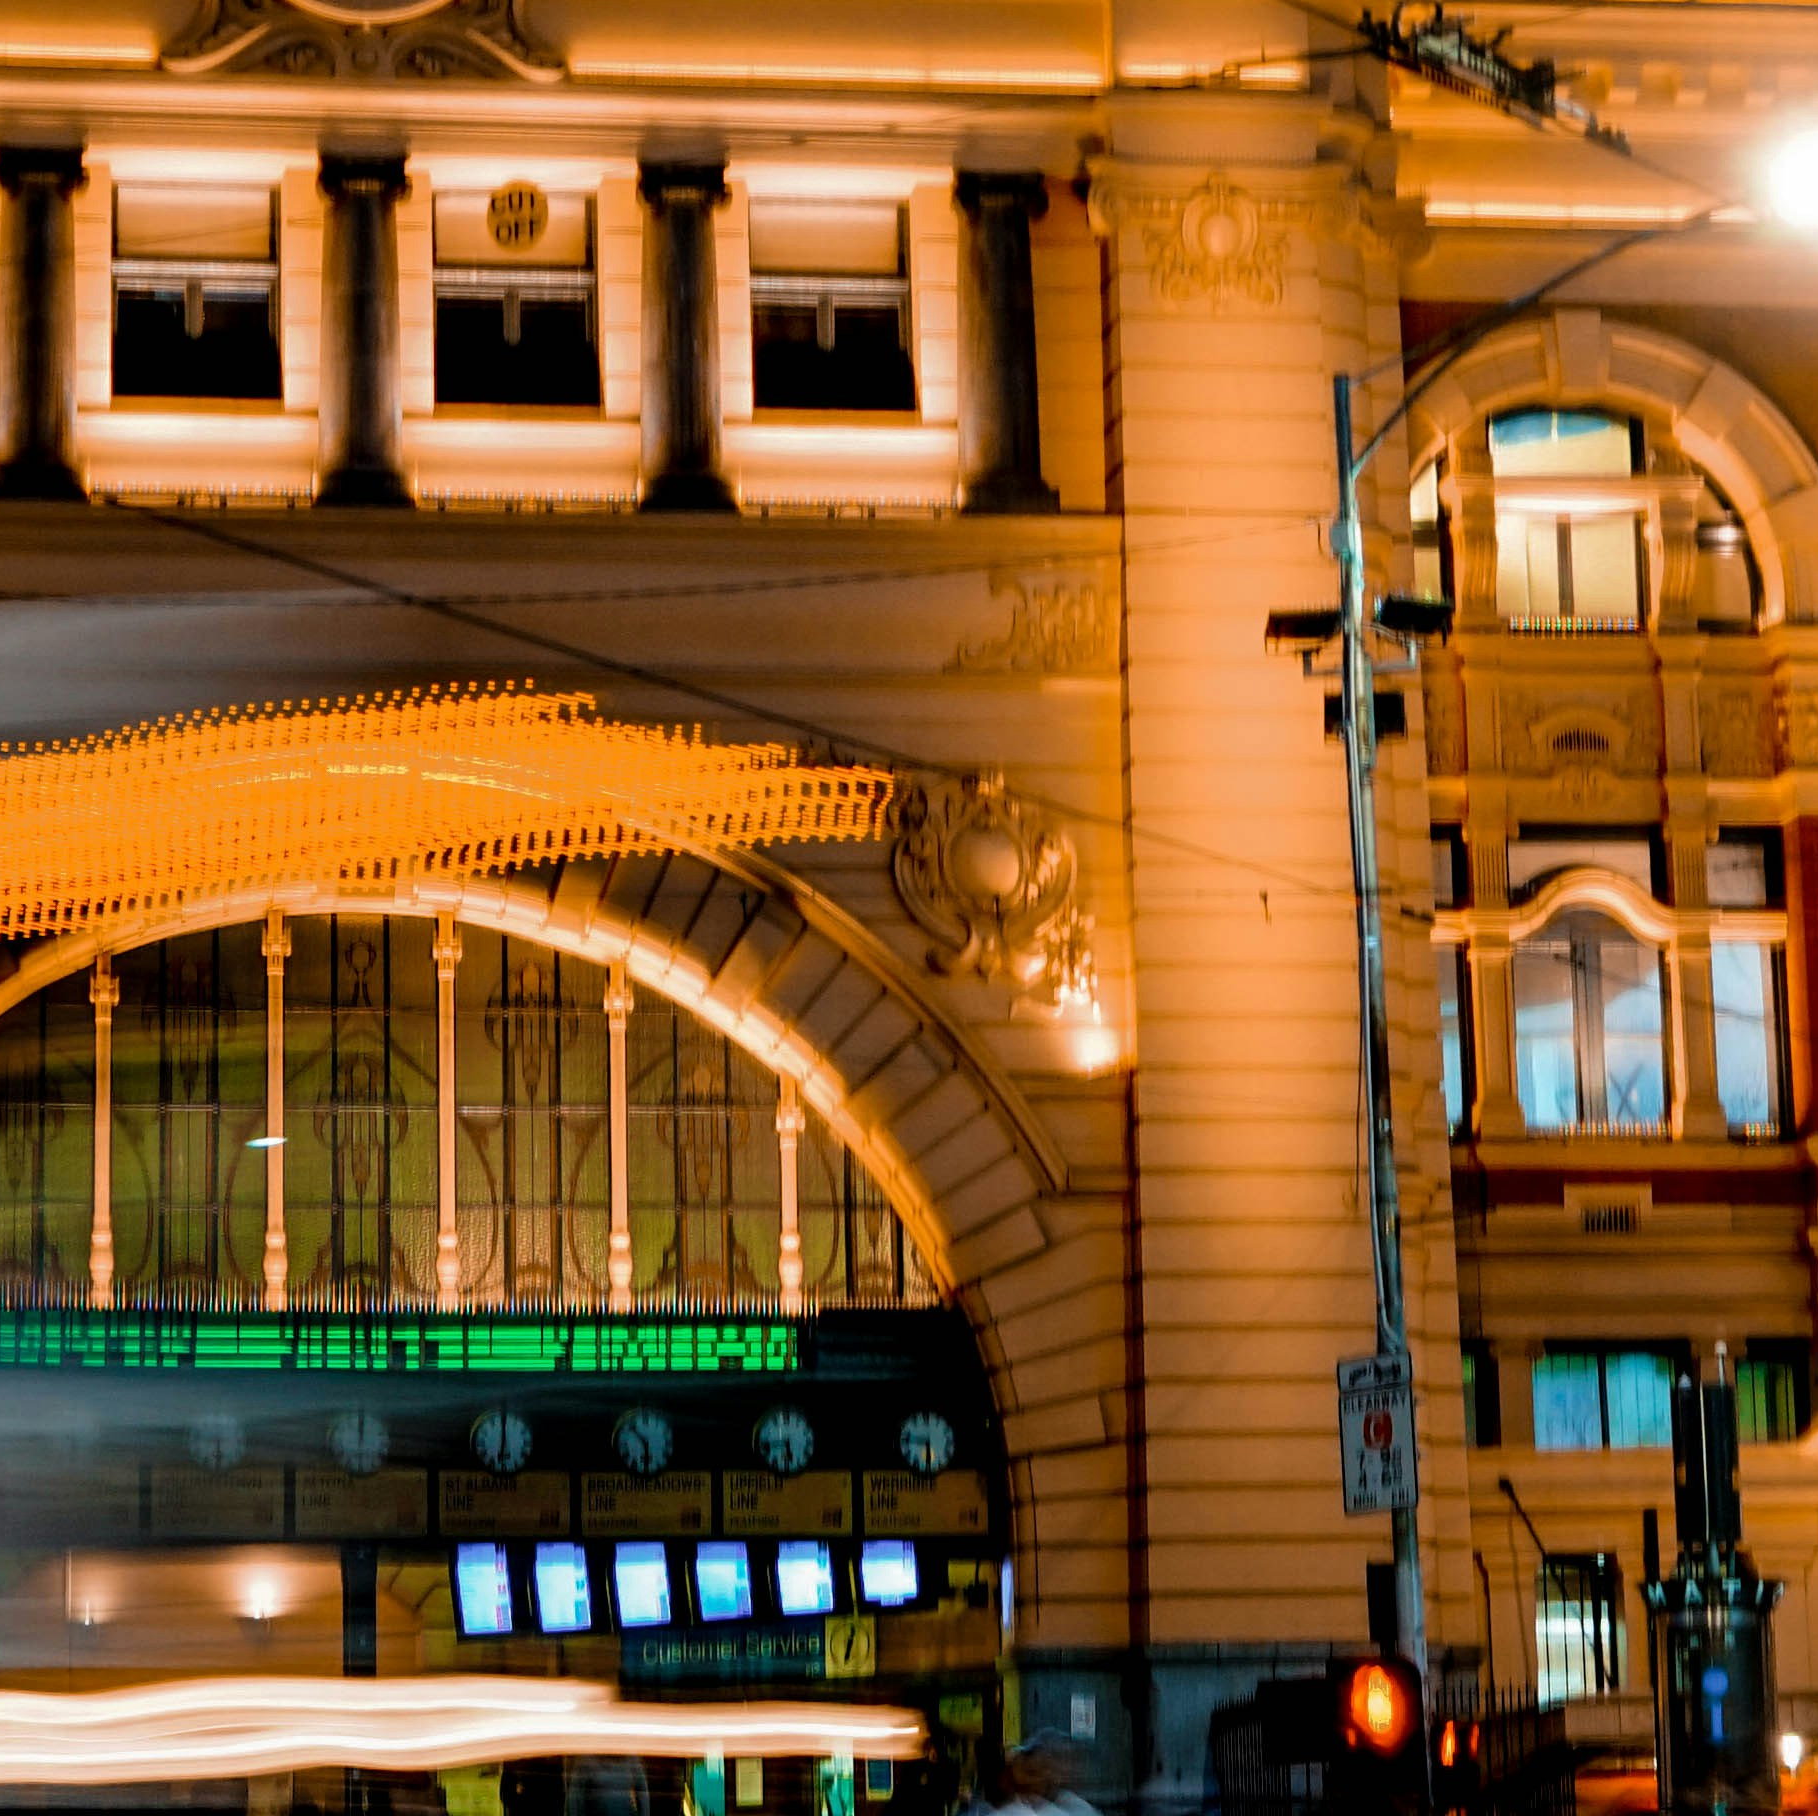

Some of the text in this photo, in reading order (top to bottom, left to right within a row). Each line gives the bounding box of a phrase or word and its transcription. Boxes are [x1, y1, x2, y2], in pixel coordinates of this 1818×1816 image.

[496, 218, 541, 243] OFF
[1344, 1390, 1407, 1413] CLEARWAY
[643, 1627, 820, 1665] Customer Service
